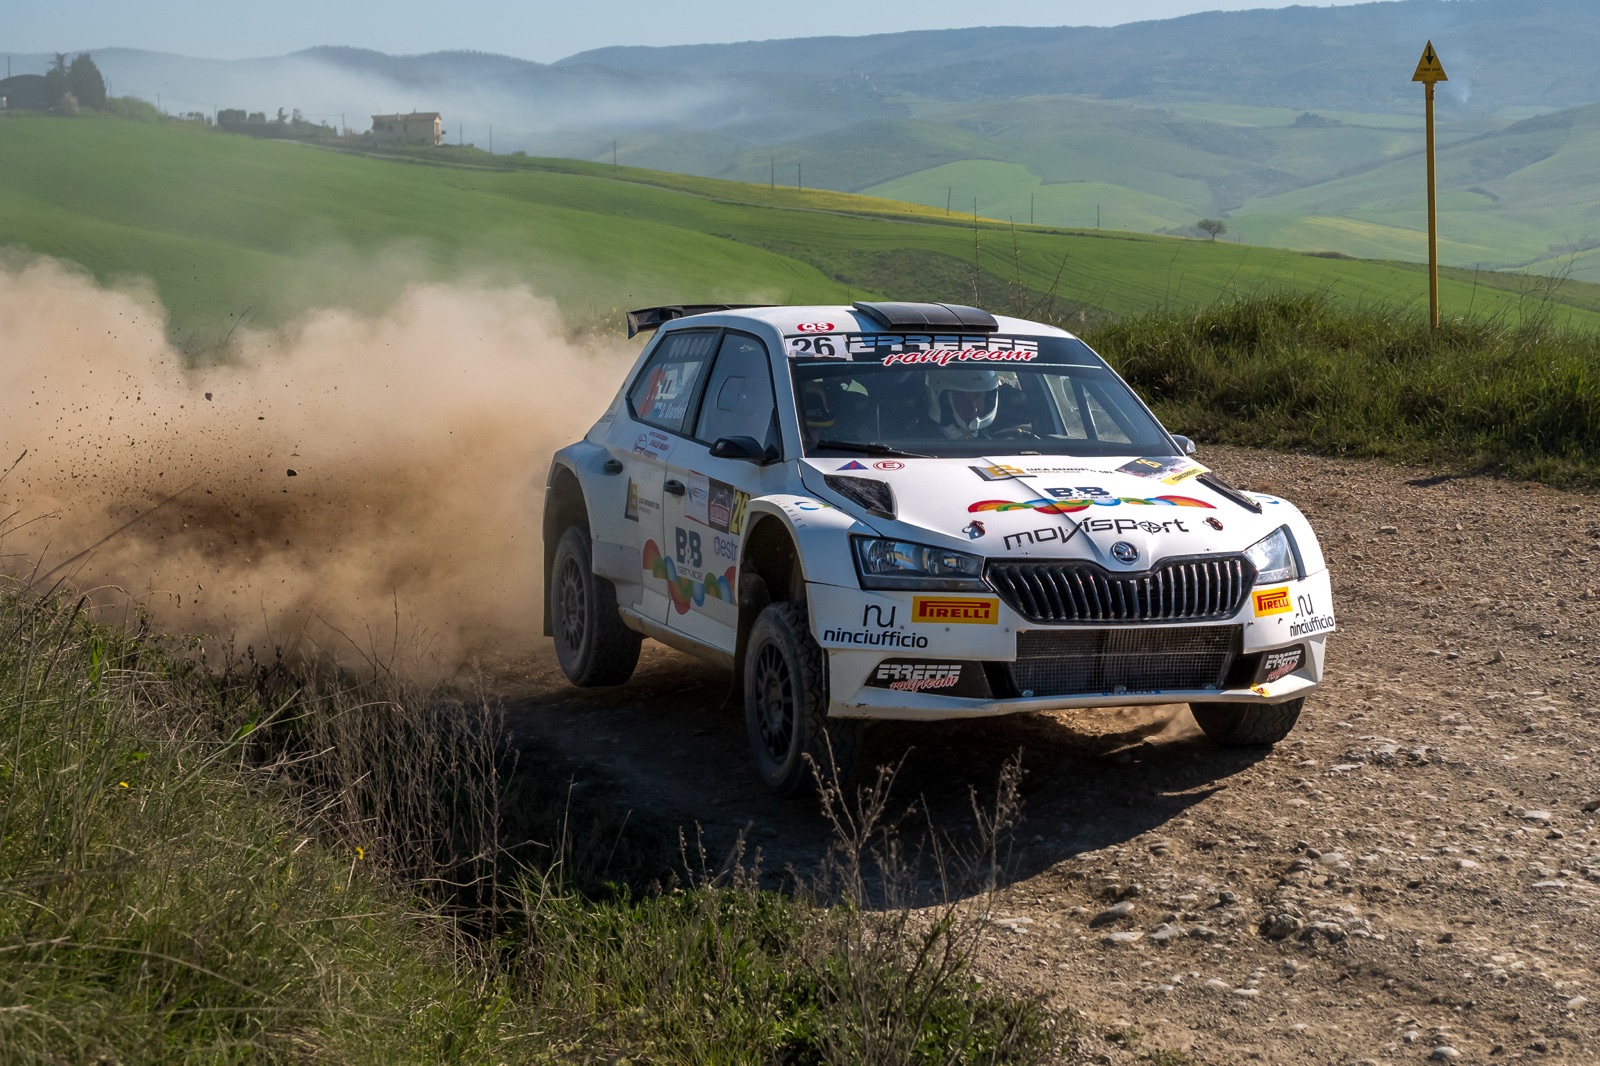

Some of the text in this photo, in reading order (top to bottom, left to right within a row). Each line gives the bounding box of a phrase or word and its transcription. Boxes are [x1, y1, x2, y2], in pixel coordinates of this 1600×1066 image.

[802, 322, 829, 331] QS
[791, 336, 836, 357] 26
[918, 600, 992, 619] PIRELLI
[1256, 591, 1290, 612] PIRELLI
[1289, 614, 1335, 637] ninciufficio
[823, 627, 929, 648] ninciufficio
